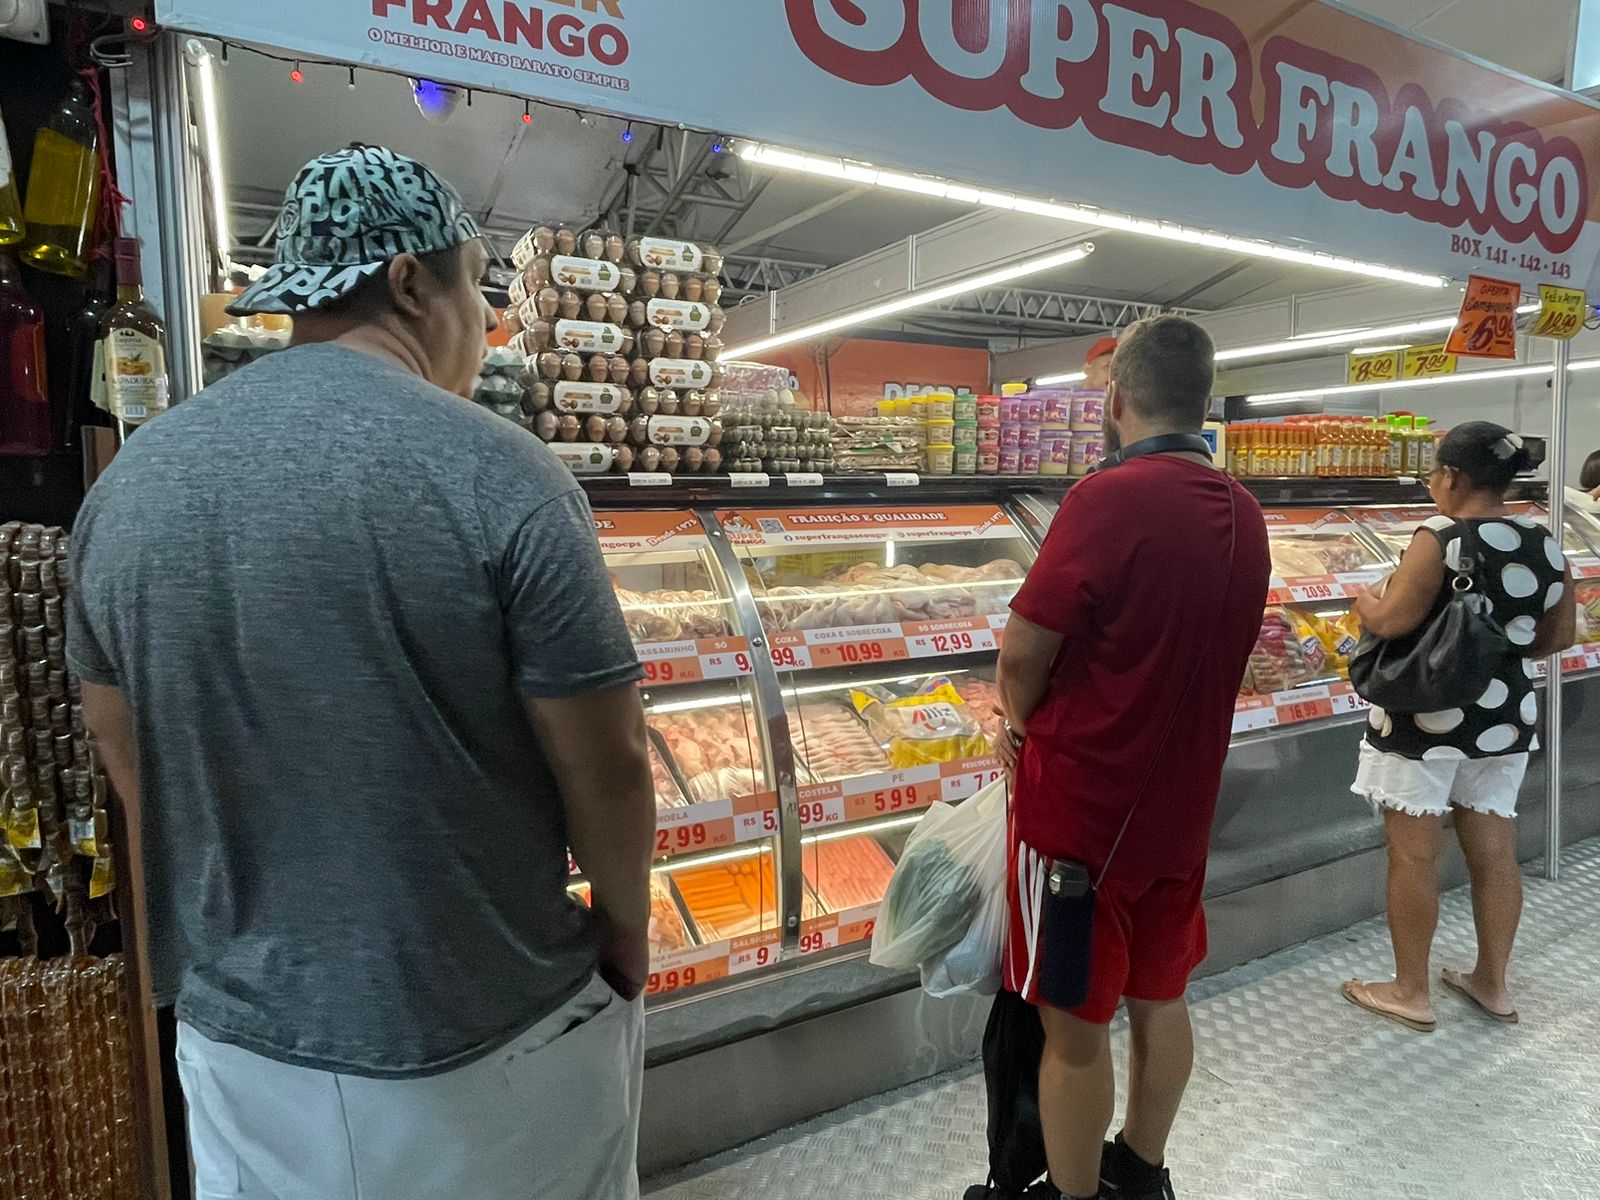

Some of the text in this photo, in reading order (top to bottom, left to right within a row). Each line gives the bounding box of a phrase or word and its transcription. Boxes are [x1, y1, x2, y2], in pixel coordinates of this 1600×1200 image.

[368, 27, 630, 91] O MELHOR E MAIS BARATO SEMPRE
[1271, 61, 1580, 235] FRANGO
[1451, 233, 1571, 279] BOX 141 142 143
[788, 510, 948, 524] TRADIÇÃO E QUALIDADE
[774, 635, 798, 645] COXA
[814, 631, 838, 640] COXA
[846, 627, 893, 638] SOBRECOXA
[930, 632, 973, 653] 12,99
[982, 640, 992, 648] KG
[836, 642, 884, 663] 10,99
[798, 784, 839, 799] COSTELA
[874, 785, 917, 812] 5,99
[743, 817, 756, 827] R$
[825, 812, 839, 822] KG
